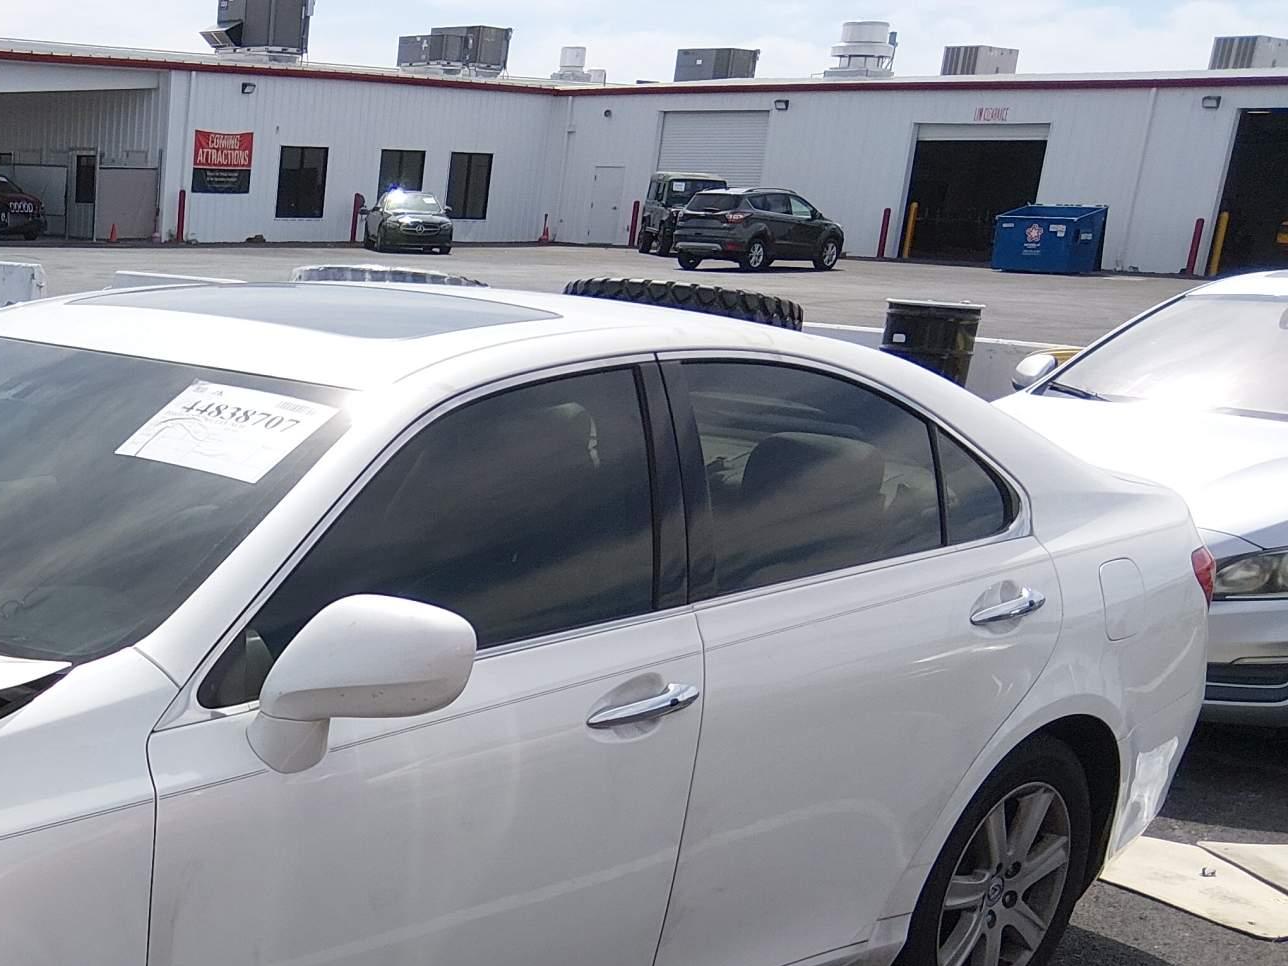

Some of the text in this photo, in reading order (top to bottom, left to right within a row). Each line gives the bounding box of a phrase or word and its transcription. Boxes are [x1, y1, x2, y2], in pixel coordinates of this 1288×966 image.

[208, 134, 241, 149] COMING
[196, 148, 249, 165] ATTRACTIONS
[182, 399, 301, 433] 44838707
